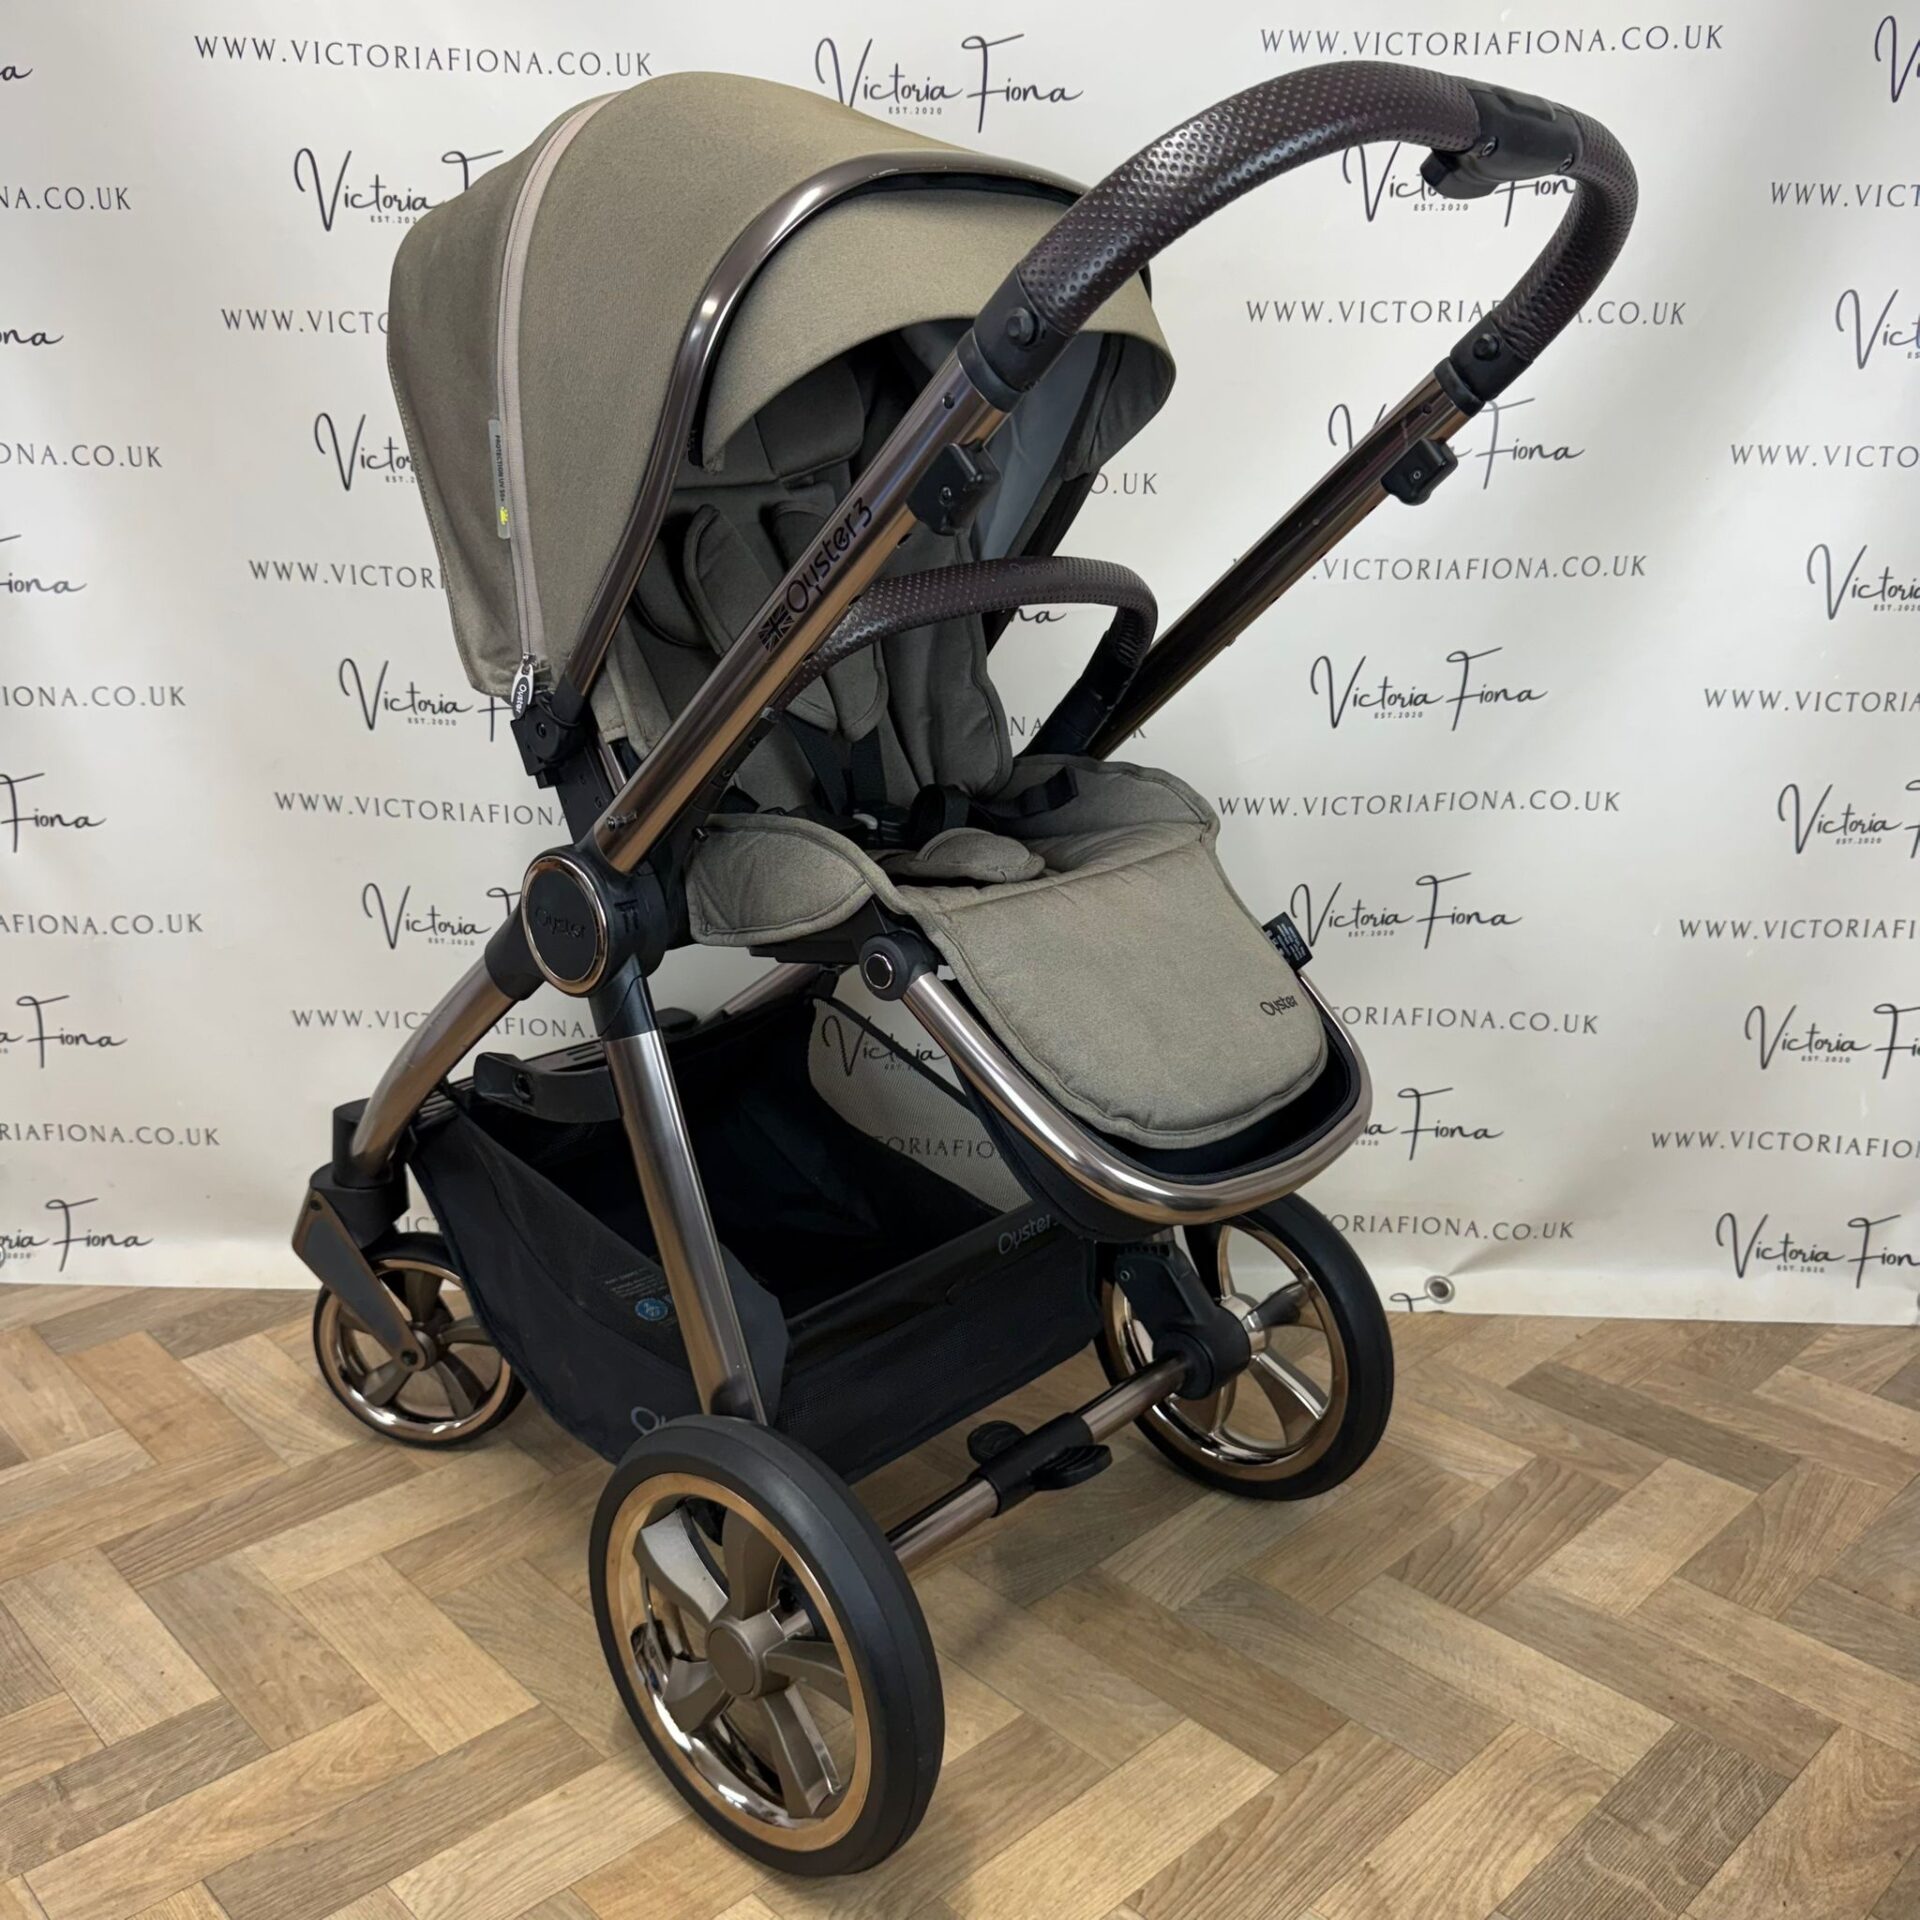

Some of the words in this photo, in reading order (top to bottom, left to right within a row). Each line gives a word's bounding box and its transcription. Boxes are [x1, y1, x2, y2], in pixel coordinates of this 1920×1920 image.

[194, 35, 652, 76] WWW.VICTORIAFIONA.CO.UK
[1260, 24, 1724, 55] WWW.VICTORIAFIONA.CO.UK
[815, 37, 963, 108] Victoria
[961, 33, 1084, 133] Fiona
[889, 106, 942, 115] EST.2020
[294, 148, 445, 232] Victoria
[1413, 203, 1469, 212] EST.2020
[339, 658, 473, 730] Victoria
[516, 684, 528, 714] Oyster
[1310, 655, 1444, 729] Victoria
[1446, 647, 1548, 731] Fiona
[0, 773, 106, 852] Fiona
[1218, 790, 1620, 817] WWW.VICTORIAFIONA.CO.UK
[1778, 783, 1902, 854] Victoria
[362, 882, 491, 949] Victoria
[1290, 882, 1414, 947] Victoria
[1416, 872, 1522, 949] Fiona
[17, 995, 127, 1068] Fiona
[1260, 995, 1298, 1016] Oyster
[1745, 1005, 1871, 1070] Victoria
[1397, 1087, 1504, 1160] Fiona
[1651, 1131, 1920, 1159] WWW.VICTORIAFIO
[45, 1198, 153, 1272] Fiona
[998, 1214, 1058, 1255] Oyster
[1715, 1213, 1845, 1279] Victoria
